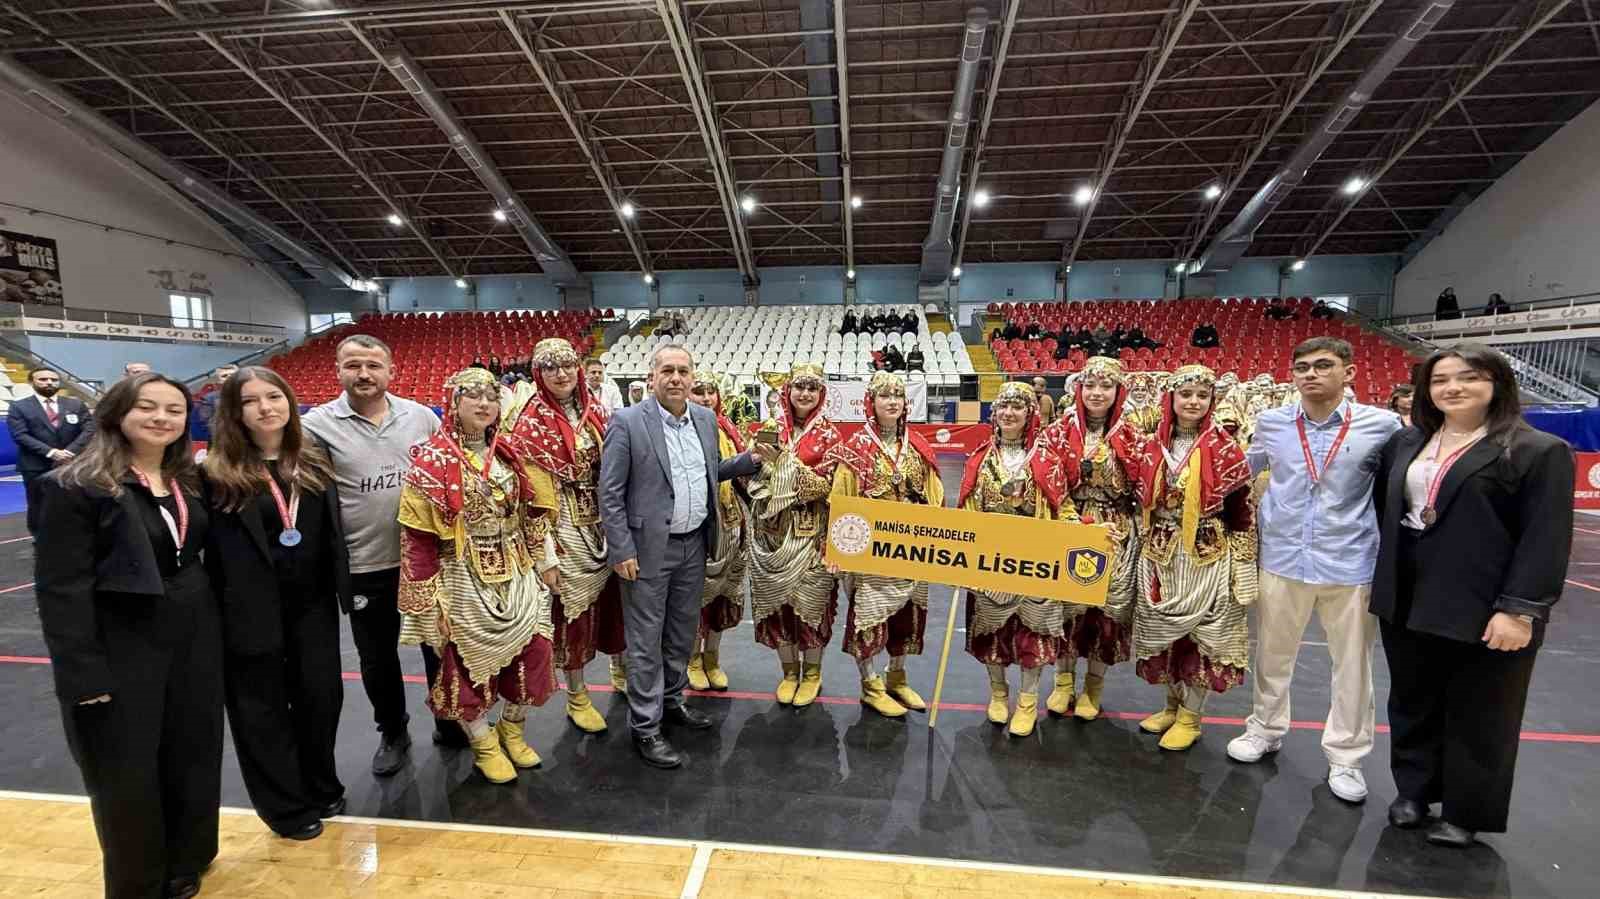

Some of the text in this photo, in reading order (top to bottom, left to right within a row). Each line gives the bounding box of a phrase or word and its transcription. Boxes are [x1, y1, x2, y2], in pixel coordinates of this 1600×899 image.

[874, 520, 976, 543] MANİSA ŞEHZADELER
[872, 541, 969, 569] MANİSA
[977, 552, 1061, 581] LİSESİ
